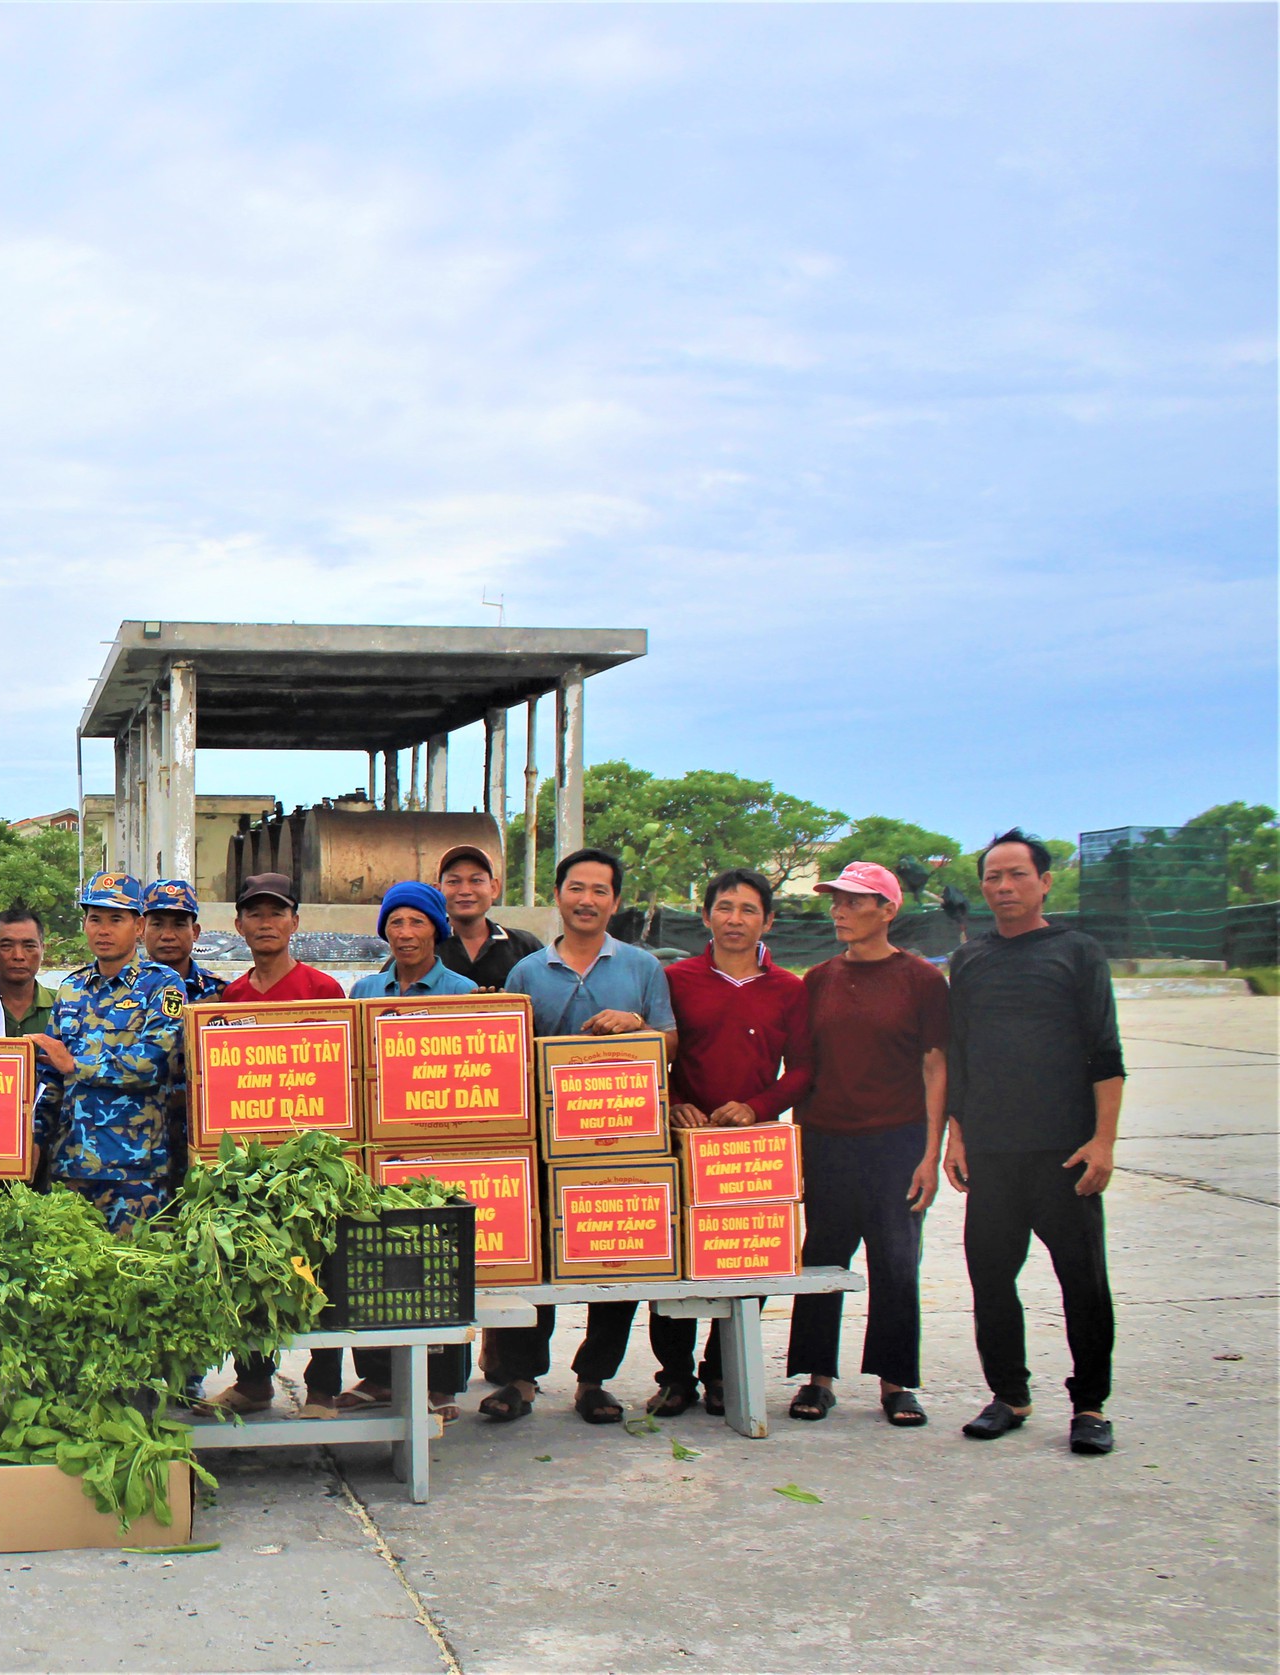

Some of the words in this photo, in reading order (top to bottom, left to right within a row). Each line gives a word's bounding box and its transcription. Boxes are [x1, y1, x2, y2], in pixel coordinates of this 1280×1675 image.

[210, 1041, 240, 1067] ĐẢO
[246, 1045, 287, 1065] SONG
[291, 1038, 310, 1063] TỬ
[314, 1040, 341, 1062] TÂY
[385, 1032, 415, 1057] ĐẢO
[421, 1036, 462, 1056] SONG
[466, 1029, 485, 1054] TỬ
[489, 1031, 516, 1053] TÂY
[238, 1071, 272, 1088] KÍNH
[279, 1069, 316, 1090] TẶNG
[412, 1062, 447, 1079] KÍNH
[454, 1061, 492, 1081] TẶNG
[561, 1075, 582, 1092] ĐẢO
[585, 1078, 612, 1091] SONG
[615, 1072, 628, 1089] TỬ
[630, 1073, 648, 1088] TÂY
[231, 1098, 275, 1119] NGƯ
[281, 1094, 323, 1118] DÂN
[406, 1088, 450, 1110] NGƯ
[455, 1085, 499, 1108] DÂN
[567, 1097, 603, 1111] KÍNH
[606, 1095, 645, 1111] TẶNG
[580, 1117, 606, 1129] NGƯ
[608, 1114, 632, 1126] DÂN
[700, 1140, 720, 1157] ĐẢO
[723, 1141, 750, 1156] SONG
[753, 1136, 766, 1153] TỬ
[768, 1136, 786, 1151] TÂY
[706, 1162, 741, 1176] KÍNH
[745, 1158, 783, 1175] TẶNG
[470, 1173, 490, 1199] TỬ
[493, 1175, 520, 1198] TÂY
[720, 1181, 746, 1194] NGƯ
[747, 1178, 772, 1192] DÂN
[571, 1196, 592, 1213] ĐẢO
[595, 1199, 623, 1212] SONG
[626, 1194, 640, 1211] TỬ
[641, 1196, 660, 1211] TÂY
[475, 1208, 496, 1221] NG
[699, 1215, 719, 1232] ĐẢO
[722, 1217, 749, 1231] SONG
[752, 1212, 766, 1229] TỬ
[767, 1213, 785, 1228] TÂY
[576, 1218, 613, 1232] KÍNH
[617, 1217, 656, 1234] TẶNG
[475, 1231, 503, 1251] ÂN
[590, 1239, 616, 1250] NGƯ
[618, 1237, 644, 1250] DÂN
[704, 1237, 739, 1250] KÍNH
[743, 1235, 781, 1251] TẶNG
[717, 1256, 742, 1269] NGƯ
[744, 1254, 768, 1268] DÂN
